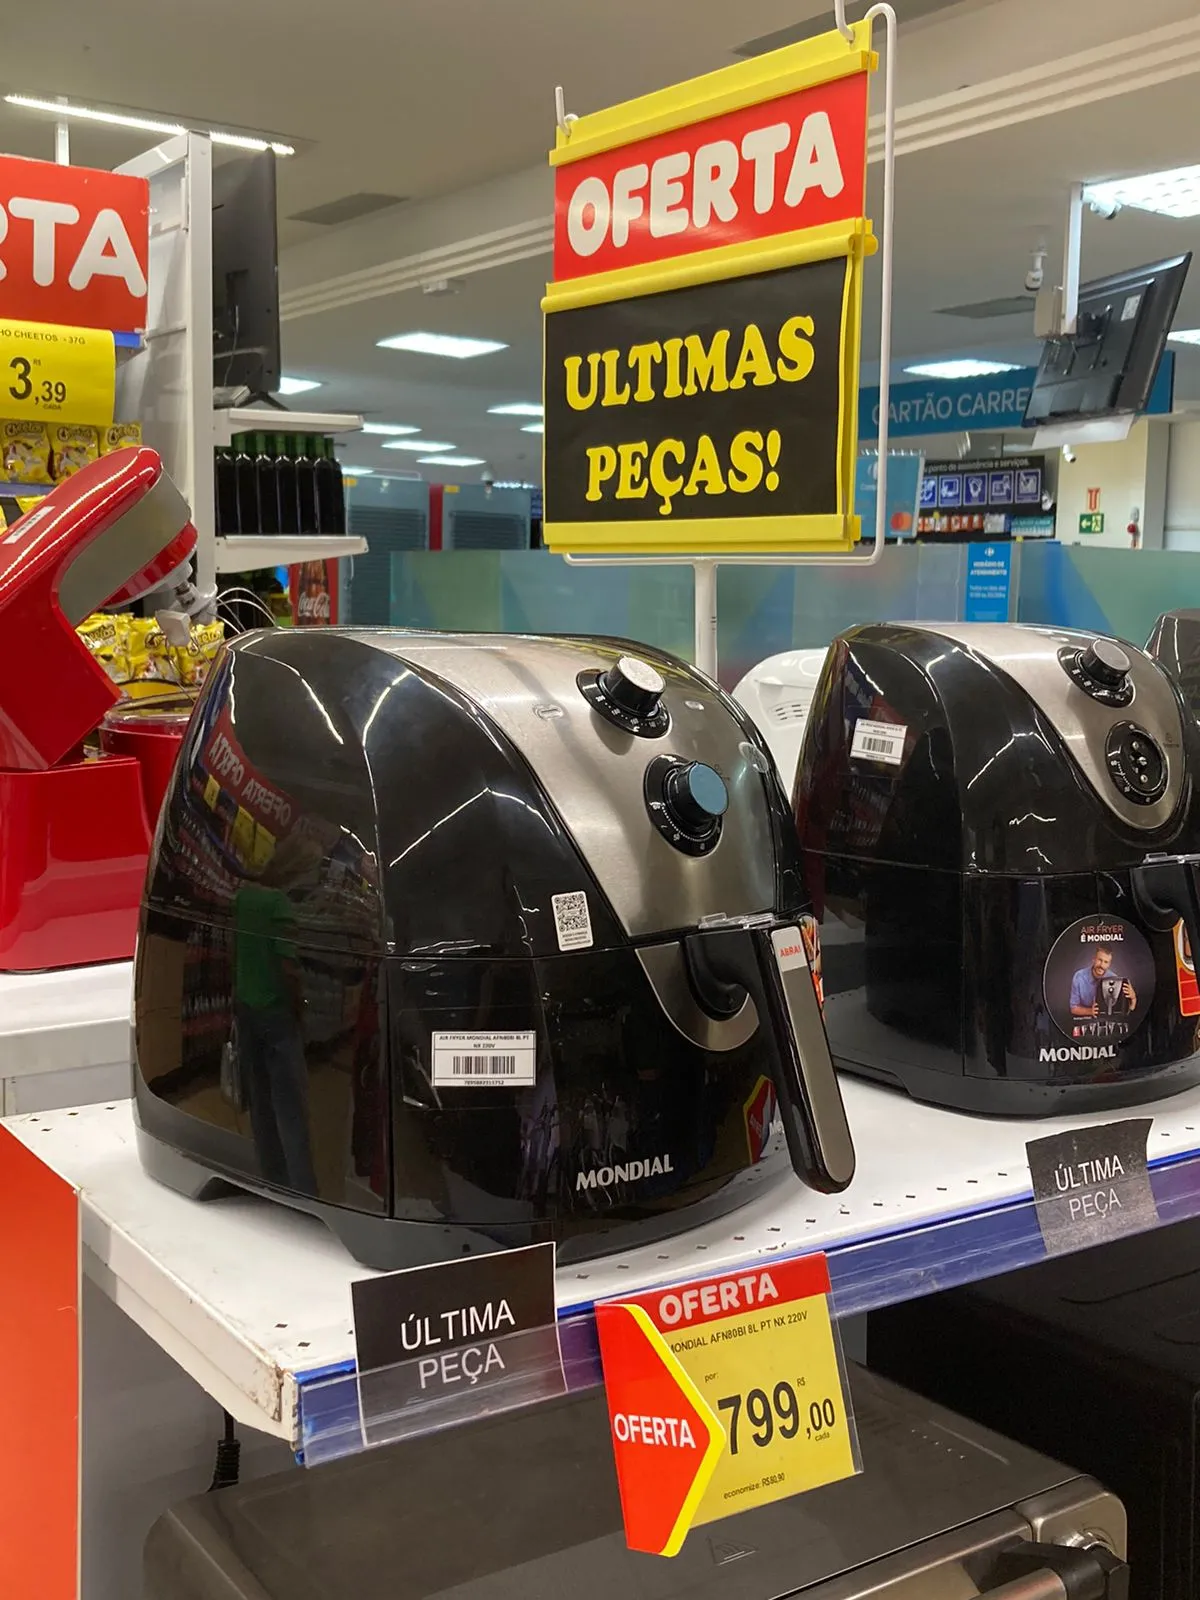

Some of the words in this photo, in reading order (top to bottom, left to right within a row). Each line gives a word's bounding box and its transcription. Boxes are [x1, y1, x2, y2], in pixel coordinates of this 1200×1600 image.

[567, 111, 845, 257] OFERTA
[0, 196, 148, 298] TA
[14, 330, 58, 342] CHEETOS
[564, 315, 816, 411] ULTIMAS
[585, 429, 782, 515] PEÇAS!
[1080, 926, 1095, 935] AIR
[1096, 925, 1124, 934] FRYER
[1087, 933, 1124, 942] MONDIAL
[1039, 1044, 1117, 1063] MONDIAL
[575, 1153, 674, 1192] MONDIAL
[1054, 1154, 1125, 1192] ÚLTIMA
[1068, 1188, 1122, 1221] PEÇA
[658, 1271, 780, 1325] OFERTA
[400, 1299, 516, 1351] ÚLTIMA
[710, 1327, 747, 1344] AFN80BI
[748, 1324, 759, 1334] 8L
[760, 1319, 772, 1331] PT
[774, 1317, 786, 1329] NX
[787, 1311, 808, 1325] 220V
[418, 1343, 505, 1389] PEÇA
[704, 1372, 719, 1383] por:
[796, 1377, 806, 1387] R$
[613, 1413, 697, 1449] OFERTA
[814, 1432, 830, 1442] cada
